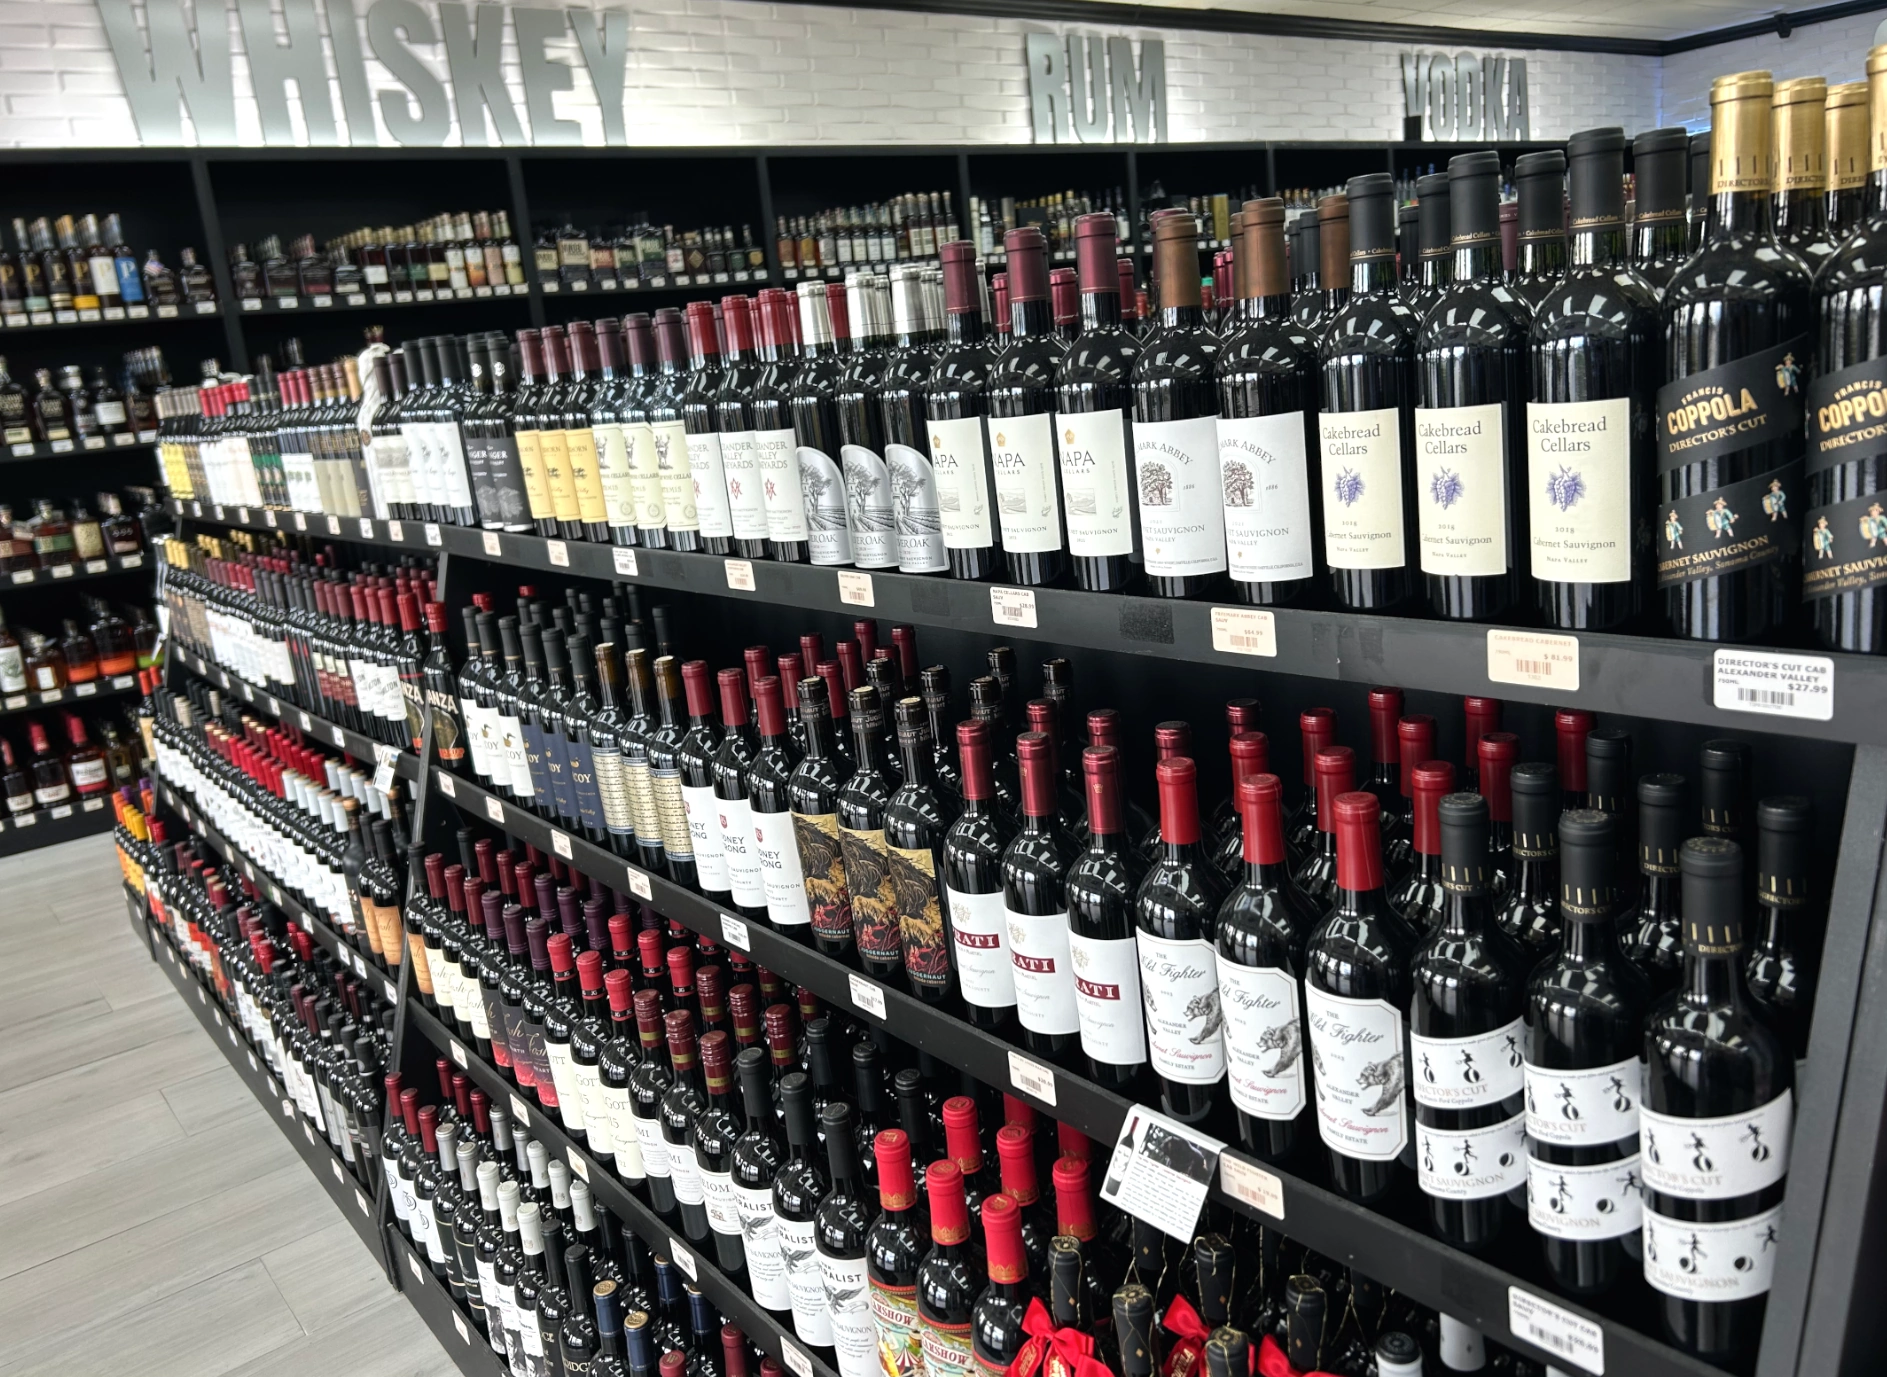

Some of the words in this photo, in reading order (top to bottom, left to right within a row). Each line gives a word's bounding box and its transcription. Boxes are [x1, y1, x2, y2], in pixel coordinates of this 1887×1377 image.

[98, 0, 629, 146] WHISKEY
[1025, 33, 1168, 143] RUM
[1401, 51, 1530, 141] VODKA
[119, 261, 136, 279] P
[1681, 386, 1724, 406] FRANCIS
[1834, 379, 1883, 401] FRANCIS
[1667, 387, 1759, 436] COPPOLA
[1322, 423, 1381, 440] Cakebread
[1418, 421, 1482, 439] Cakebread
[1532, 416, 1607, 435] Cakebread
[1668, 424, 1737, 453] DIRECTOR'S
[1737, 413, 1768, 433] CUT
[1241, 440, 1277, 465] ABBEY
[1328, 443, 1368, 456] Cellars
[1424, 441, 1468, 455] Cellars
[1540, 437, 1591, 453] Cellars
[1160, 443, 1194, 466] ABBEY
[1153, 524, 1205, 535] SAUVIGNON
[1236, 527, 1289, 538] SAUVIGNON
[1348, 531, 1392, 541] Sauvignon
[1445, 536, 1493, 546] Sauvignon
[1563, 540, 1616, 550] Sauvignon
[1693, 535, 1769, 564] SAUVIGNON
[1550, 654, 1573, 662] 81.99
[1718, 657, 1779, 670] DIRECTOR'S
[1782, 663, 1802, 672] CUT
[1805, 665, 1827, 674] CAB
[1718, 667, 1778, 679] ALEXANDER
[1780, 673, 1819, 683] VALLEY
[1788, 683, 1828, 694] $27.99
[953, 929, 995, 947] RATI
[1156, 952, 1167, 960] THE
[1159, 963, 1206, 982] Fighter
[1229, 977, 1240, 986] THE
[1233, 989, 1281, 1011] Fighter
[1326, 1010, 1339, 1020] THE
[1330, 1022, 1384, 1046] Fighter
[1169, 1048, 1213, 1063] Sauvignon
[1243, 1078, 1287, 1096] Sauvignon
[1326, 1083, 1360, 1098] ALEXANDER
[1462, 1083, 1488, 1095] CUT
[1332, 1093, 1353, 1104] VALLEY
[1339, 1117, 1389, 1136] Sauvignon
[1560, 1123, 1587, 1133] CUT
[701, 1178, 733, 1193] EIOM
[1436, 1173, 1504, 1187] SAUVIGNON
[1691, 1174, 1723, 1186] CUT
